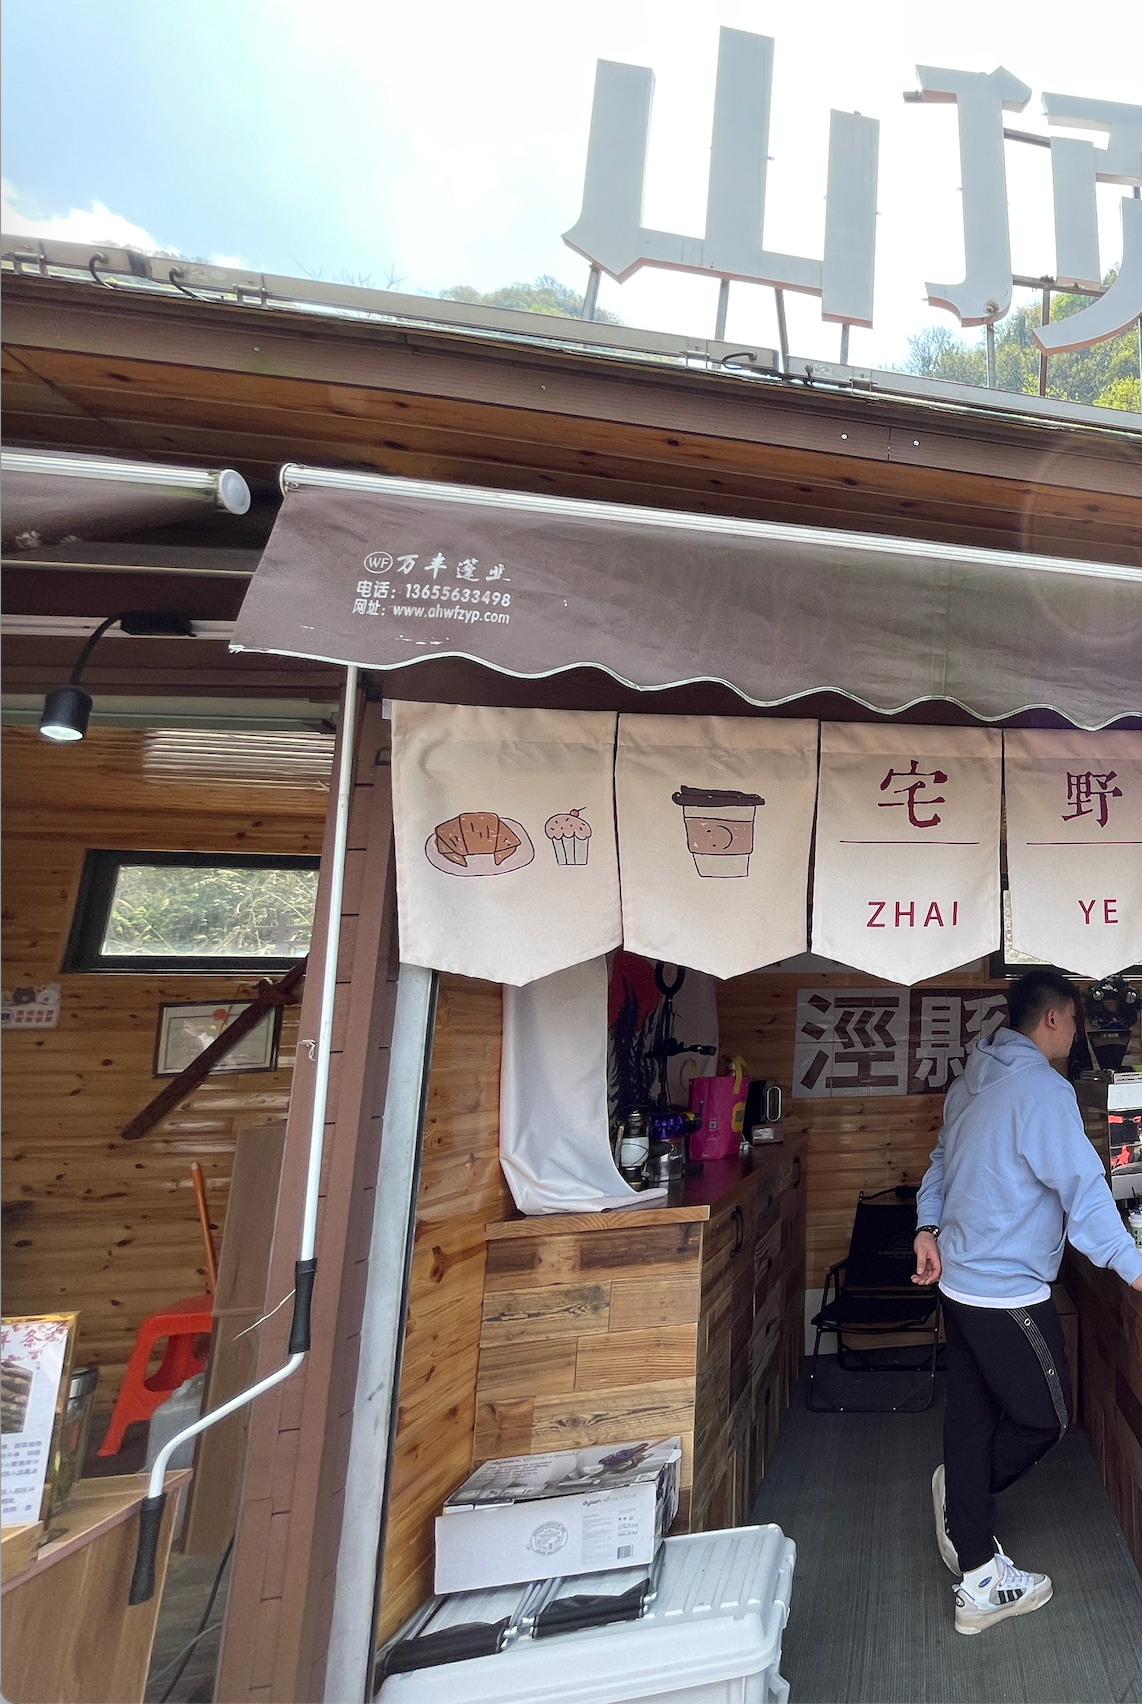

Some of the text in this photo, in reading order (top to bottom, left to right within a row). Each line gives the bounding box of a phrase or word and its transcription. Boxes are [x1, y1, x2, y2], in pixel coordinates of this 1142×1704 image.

[369, 557, 390, 569] WF
[405, 583, 511, 607] 13655633498
[393, 603, 510, 624] www.ahwfzyp.com
[878, 760, 948, 828] 宅
[1062, 770, 1123, 828] 野
[867, 901, 960, 928] ZHAI
[1078, 899, 1119, 924] YE
